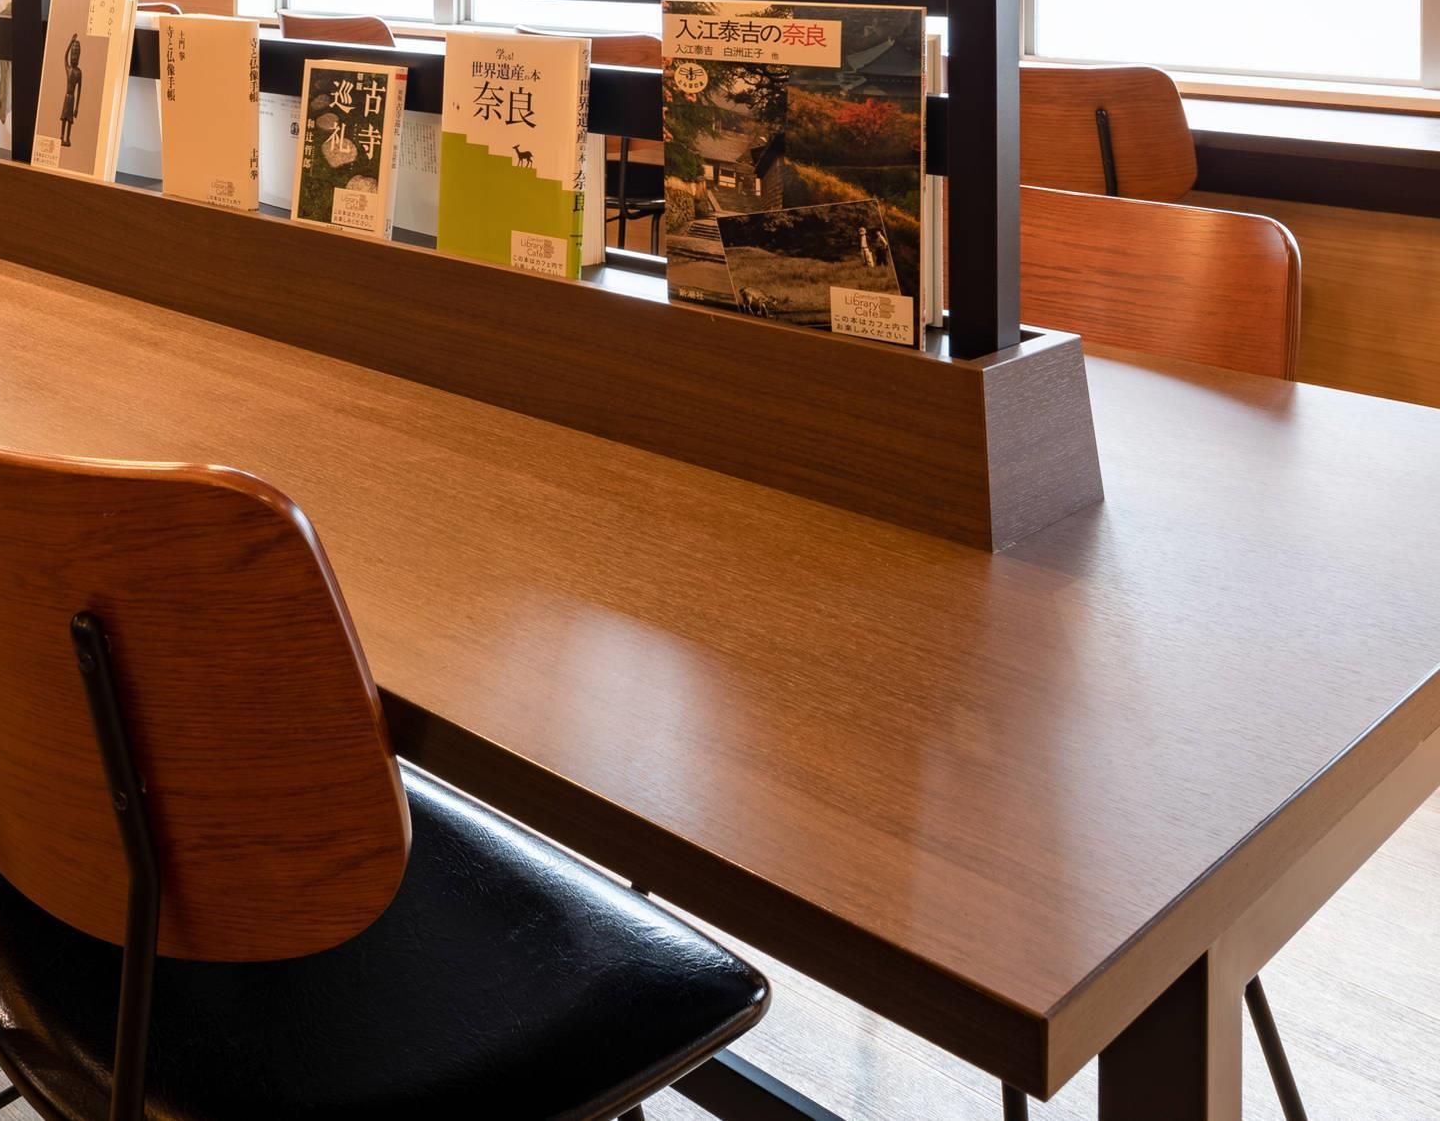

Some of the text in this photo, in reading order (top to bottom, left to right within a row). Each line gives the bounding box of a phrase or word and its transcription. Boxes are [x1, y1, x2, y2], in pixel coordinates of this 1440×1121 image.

[675, 18, 827, 47] 入江泰吉の奈良
[675, 44, 713, 56] 入江泰吉
[723, 47, 764, 59] 白洲正子
[166, 25, 175, 102] 寺と仏像手帳
[471, 61, 541, 82] 世界遺産の本
[473, 81, 537, 128] 奈良
[325, 79, 357, 154] 巡礼
[358, 80, 386, 160] 古寺
[844, 294, 880, 311] Library
[854, 307, 879, 318] Cafe
[834, 314, 909, 332] この本はカフェ内で
[836, 322, 907, 341] お楽しみください。
